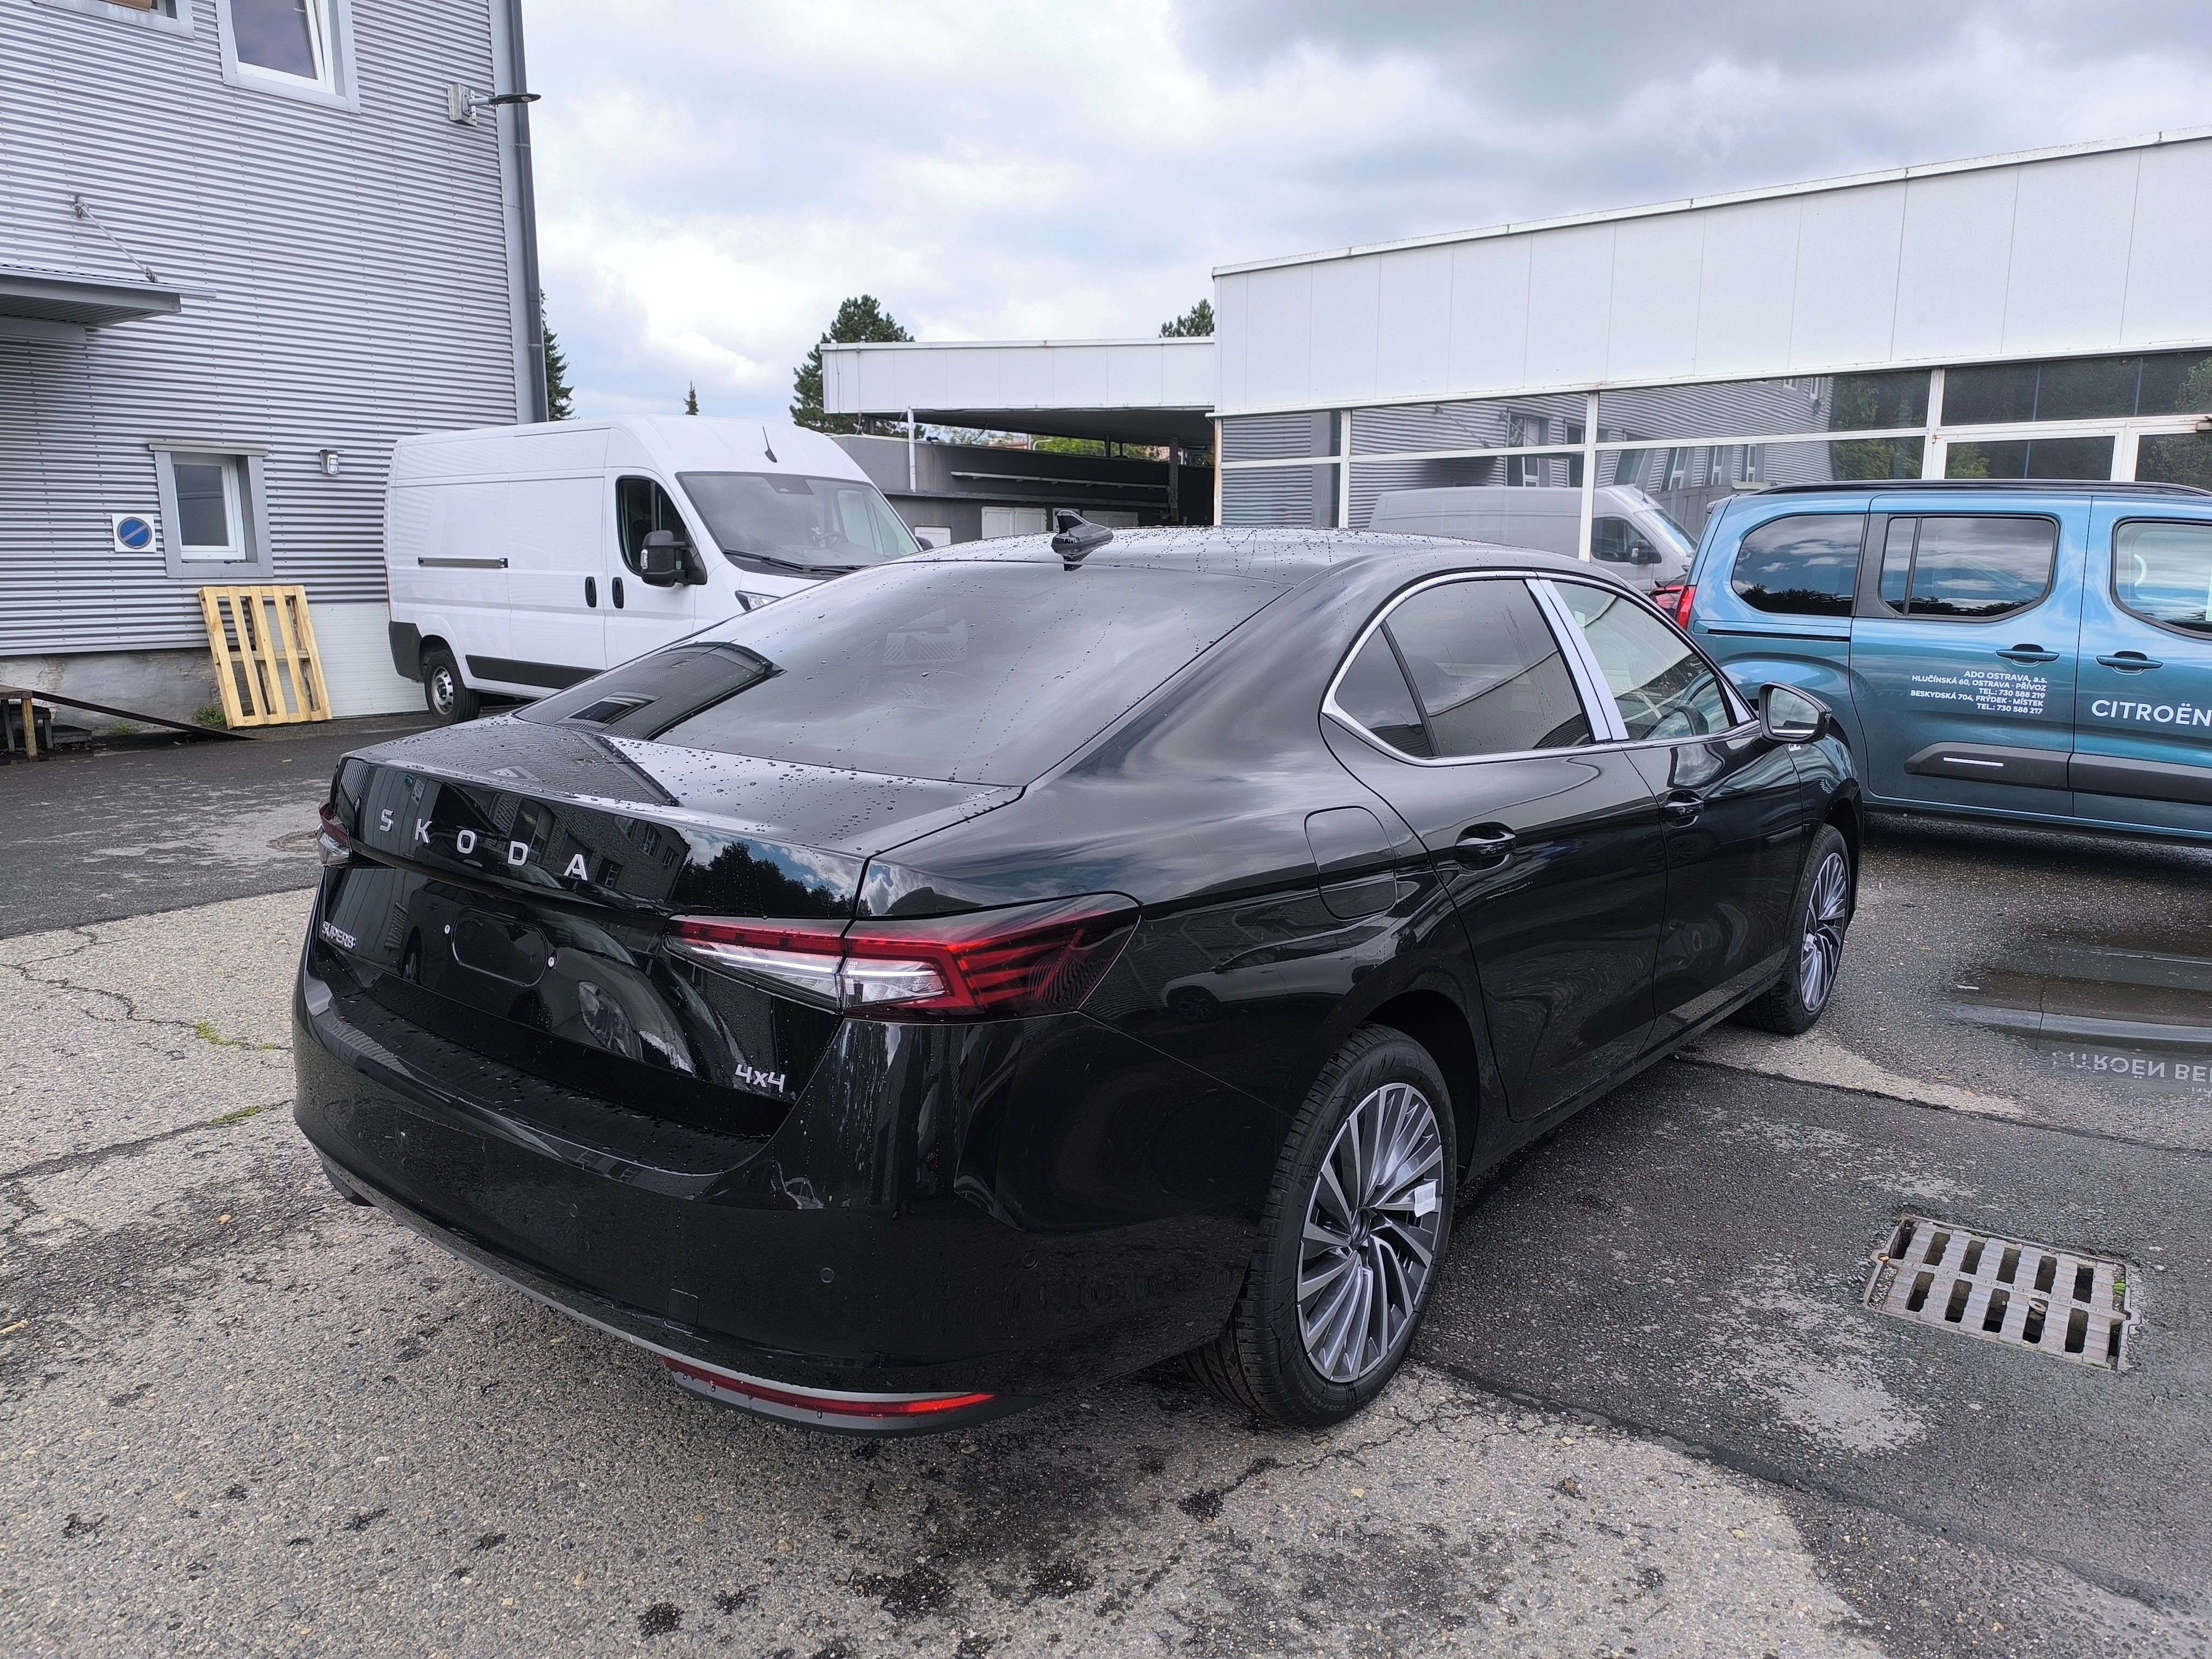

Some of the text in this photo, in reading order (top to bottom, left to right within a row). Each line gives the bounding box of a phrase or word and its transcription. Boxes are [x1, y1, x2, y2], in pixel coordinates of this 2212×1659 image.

[1912, 674, 1957, 684] HLUČÍNSKÁ
[1972, 679, 2010, 689] OSTRAVA
[2015, 681, 2047, 691] PŘÍVOZ
[1986, 672, 2031, 684] OSTRAVA,
[1910, 690, 1957, 699] BESKYDSKÁ
[1958, 693, 1974, 702] 704,
[1975, 695, 2008, 704] FRÝDEK
[2012, 697, 2044, 707] MÍSTEK
[2091, 699, 2212, 726] CITROËN
[321, 921, 357, 949] SUPERB
[735, 1064, 786, 1092] 4x4
